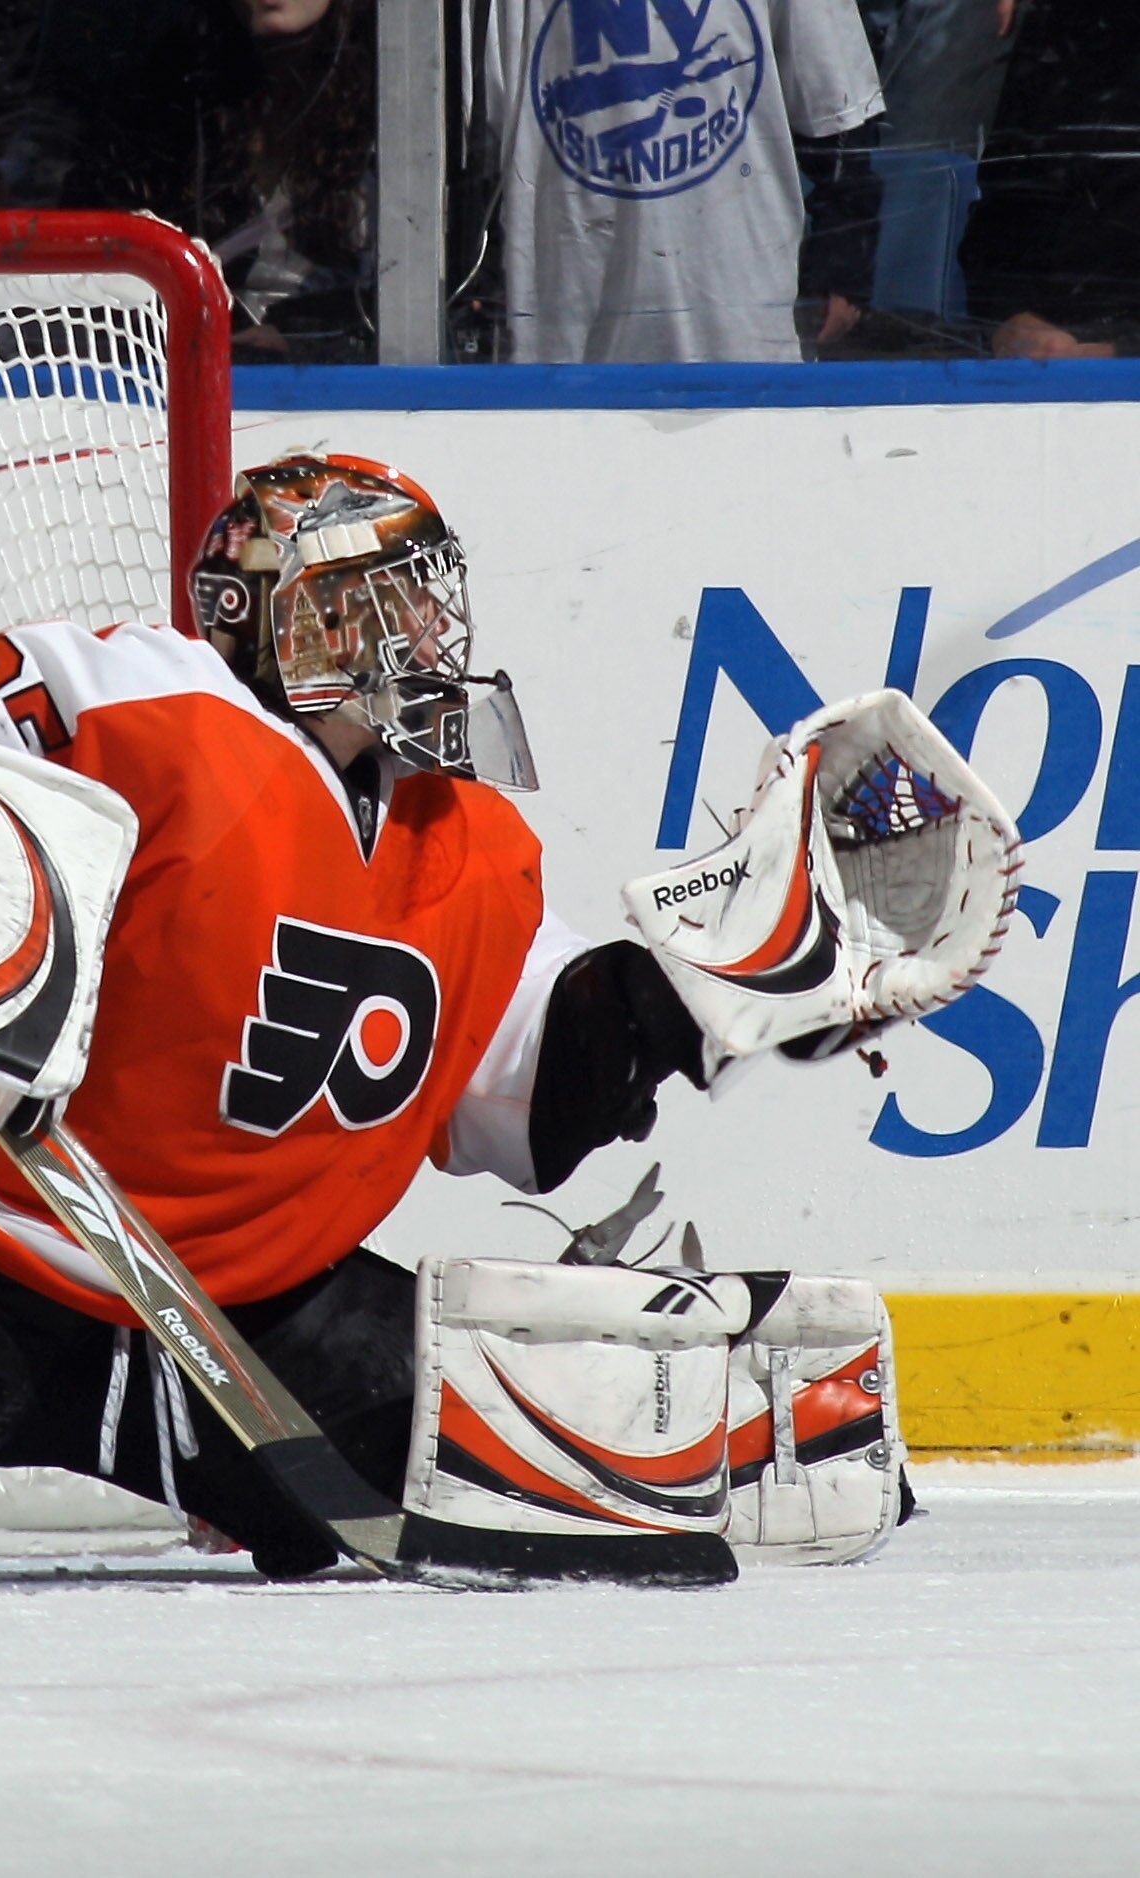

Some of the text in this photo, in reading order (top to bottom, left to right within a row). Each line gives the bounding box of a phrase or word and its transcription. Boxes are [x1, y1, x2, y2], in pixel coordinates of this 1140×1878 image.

[569, 0, 710, 66] NY
[550, 86, 742, 184] ISLANDERS
[656, 584, 1140, 852] No
[652, 860, 752, 912] Reebok
[157, 1307, 231, 1387] Reebok
